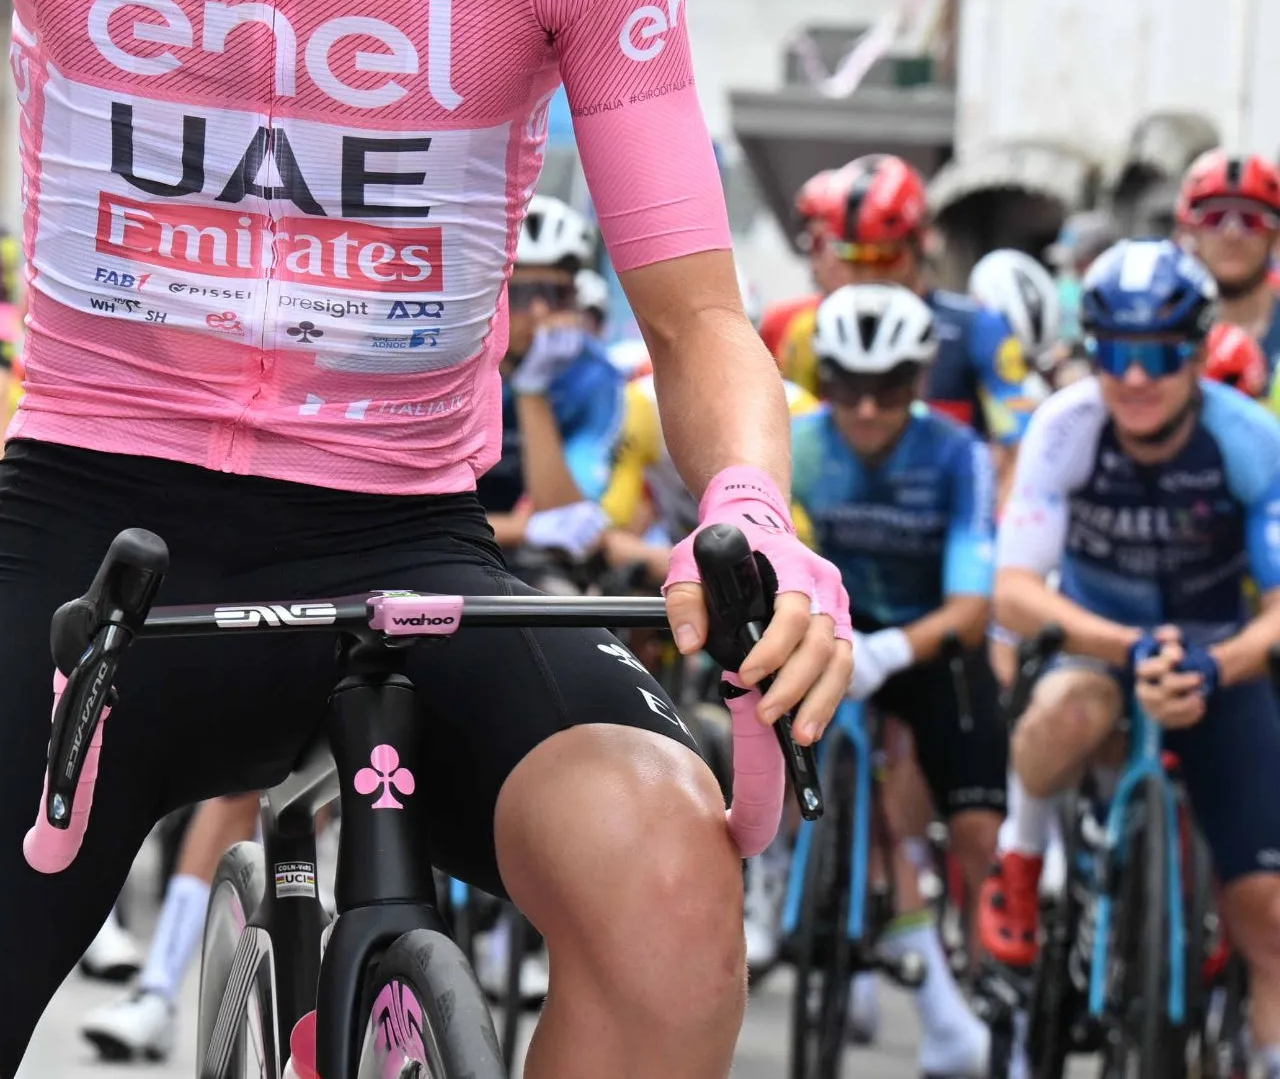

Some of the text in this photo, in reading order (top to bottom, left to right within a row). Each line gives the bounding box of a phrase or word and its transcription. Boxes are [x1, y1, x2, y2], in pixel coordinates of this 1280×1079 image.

[110, 101, 433, 218] UAE
[107, 202, 433, 283] Emirates
[188, 286, 252, 300] PISSEI
[278, 295, 369, 318] presight
[371, 341, 407, 349] ADNOC
[392, 613, 454, 627] wahoo
[285, 873, 306, 884] UCI
